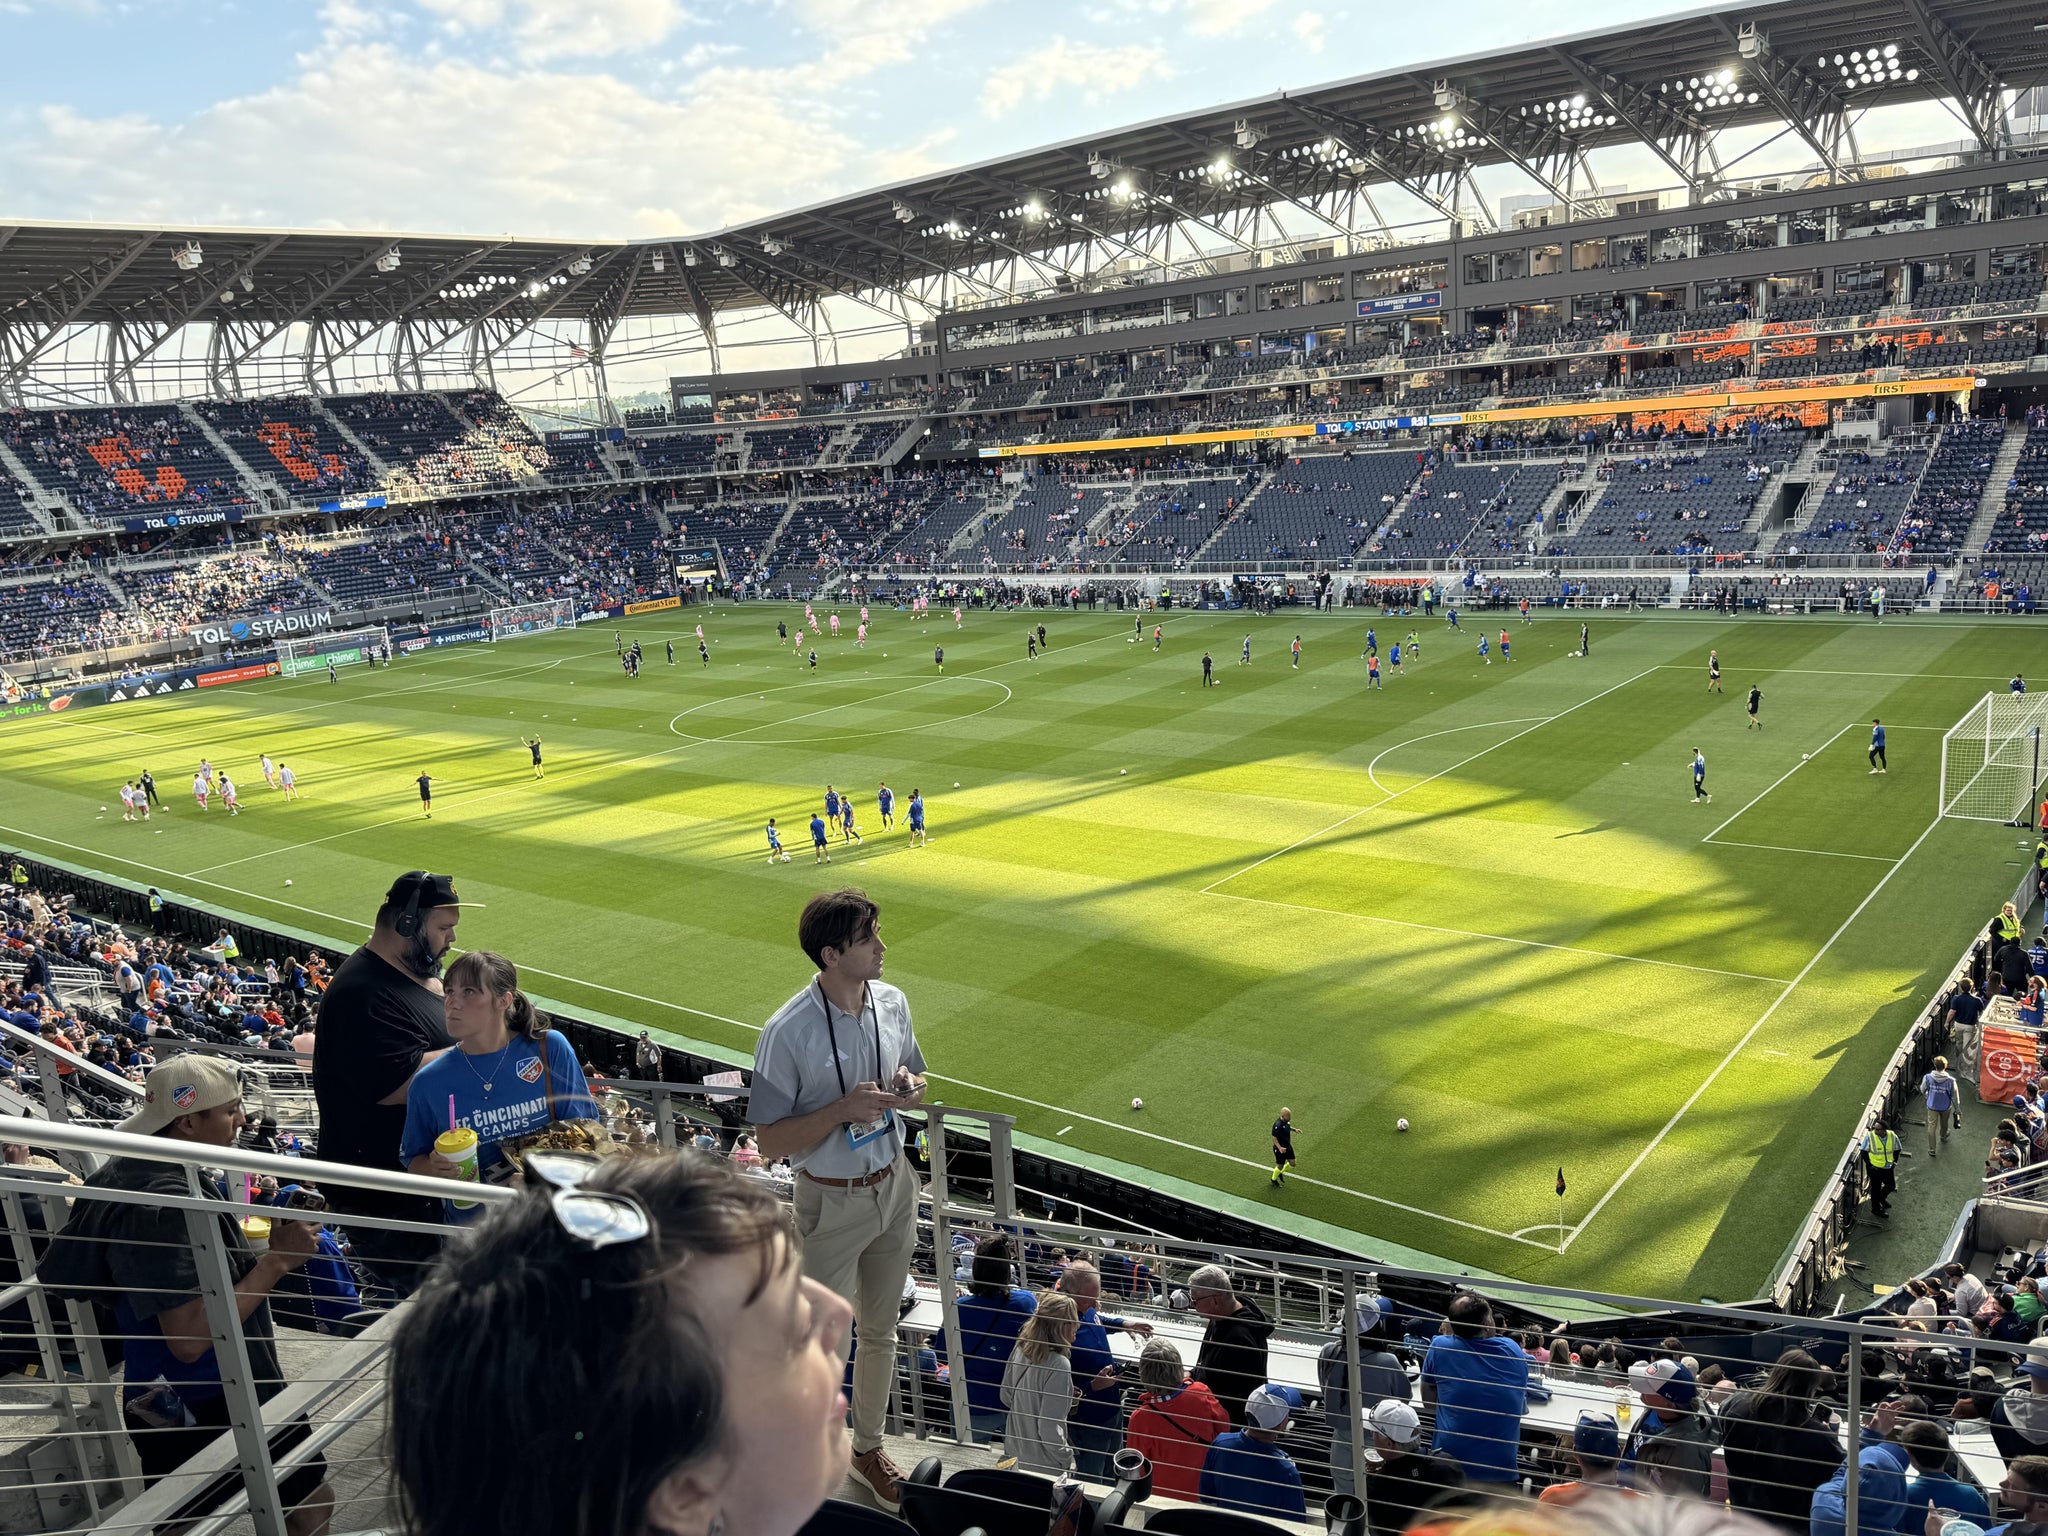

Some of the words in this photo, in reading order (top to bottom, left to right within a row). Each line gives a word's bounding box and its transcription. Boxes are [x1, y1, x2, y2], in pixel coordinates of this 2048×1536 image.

[1354, 418, 1398, 431] STADIUM
[559, 432, 590, 441] CINCINNATI
[144, 518, 168, 529] TQL
[179, 512, 226, 526] STADIUM
[629, 602, 660, 613] Continental
[581, 611, 609, 622] Gillette
[190, 626, 230, 646] TQL
[251, 612, 332, 636] STADIUM
[503, 624, 523, 634] TQL
[400, 637, 430, 648] DISCOUNT
[14, 704, 31, 716] for
[33, 703, 46, 712] it.
[2030, 954, 2045, 965] 75
[473, 1096, 548, 1127] CINCINNATI
[482, 1117, 530, 1137] CAMPS
